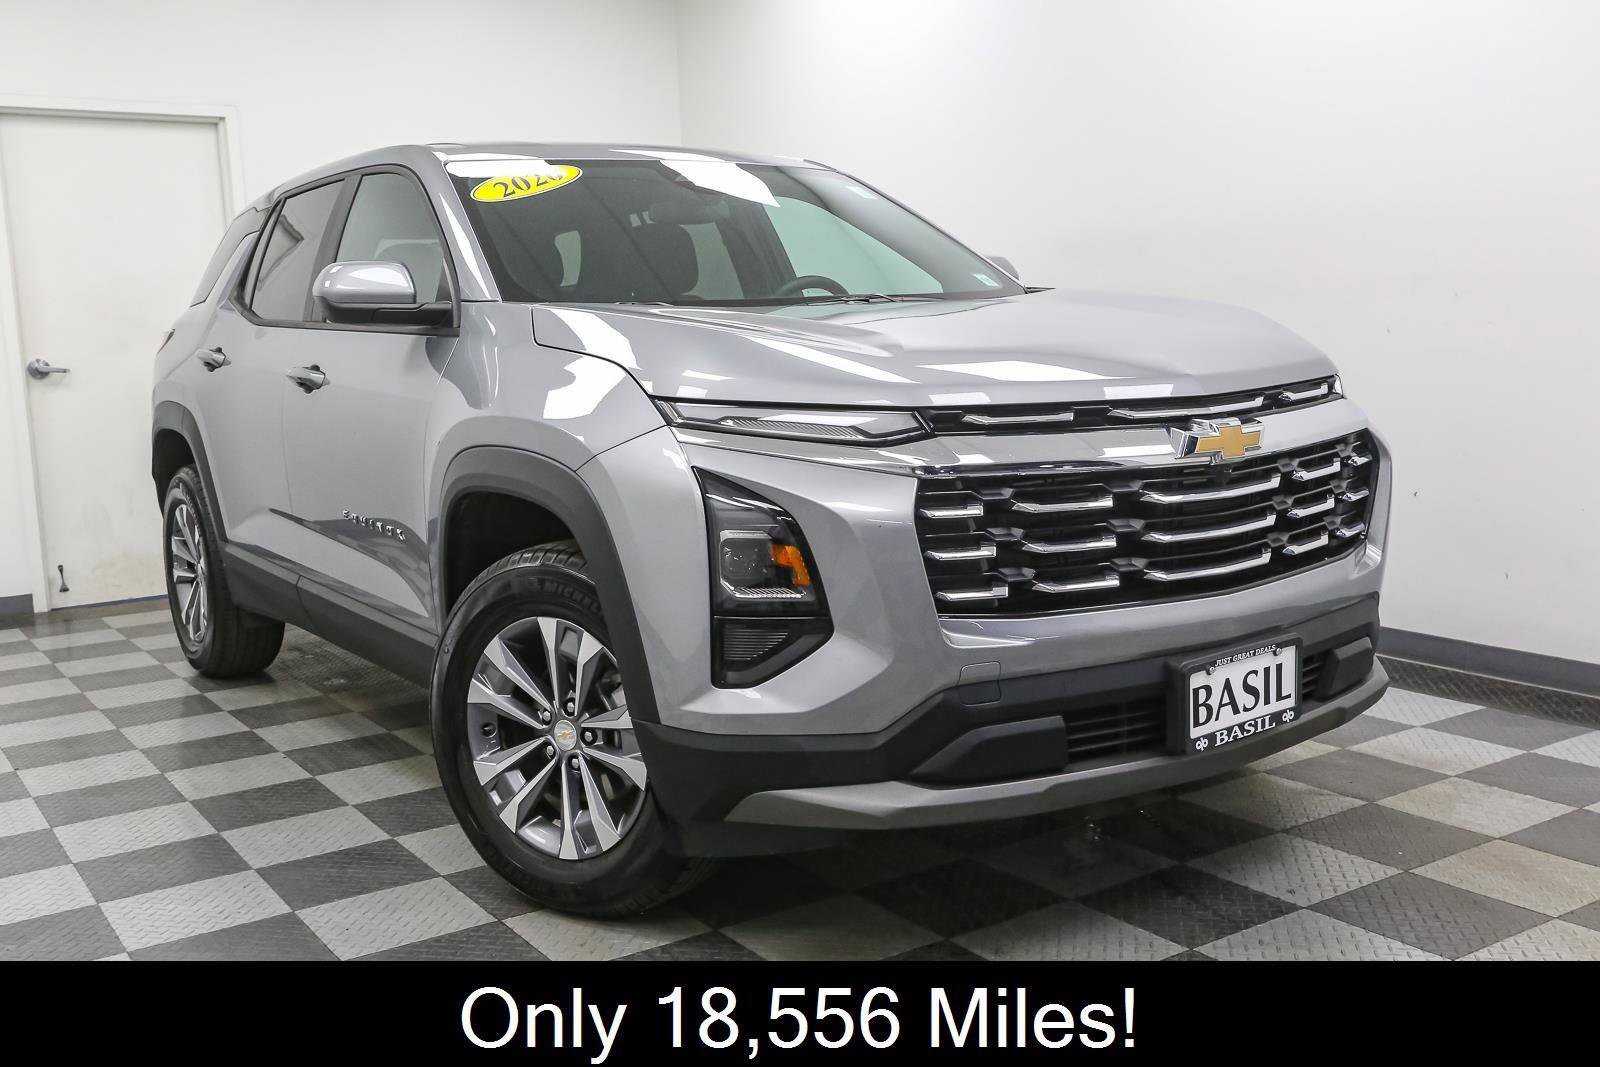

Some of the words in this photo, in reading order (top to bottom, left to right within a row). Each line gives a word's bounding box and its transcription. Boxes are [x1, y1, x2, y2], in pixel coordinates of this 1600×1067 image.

[1214, 656, 1232, 667] JUST
[1232, 650, 1255, 662] GREAT
[1255, 644, 1276, 656] DEALS
[1192, 662, 1292, 729] BASIL
[1214, 715, 1276, 747] BASIL
